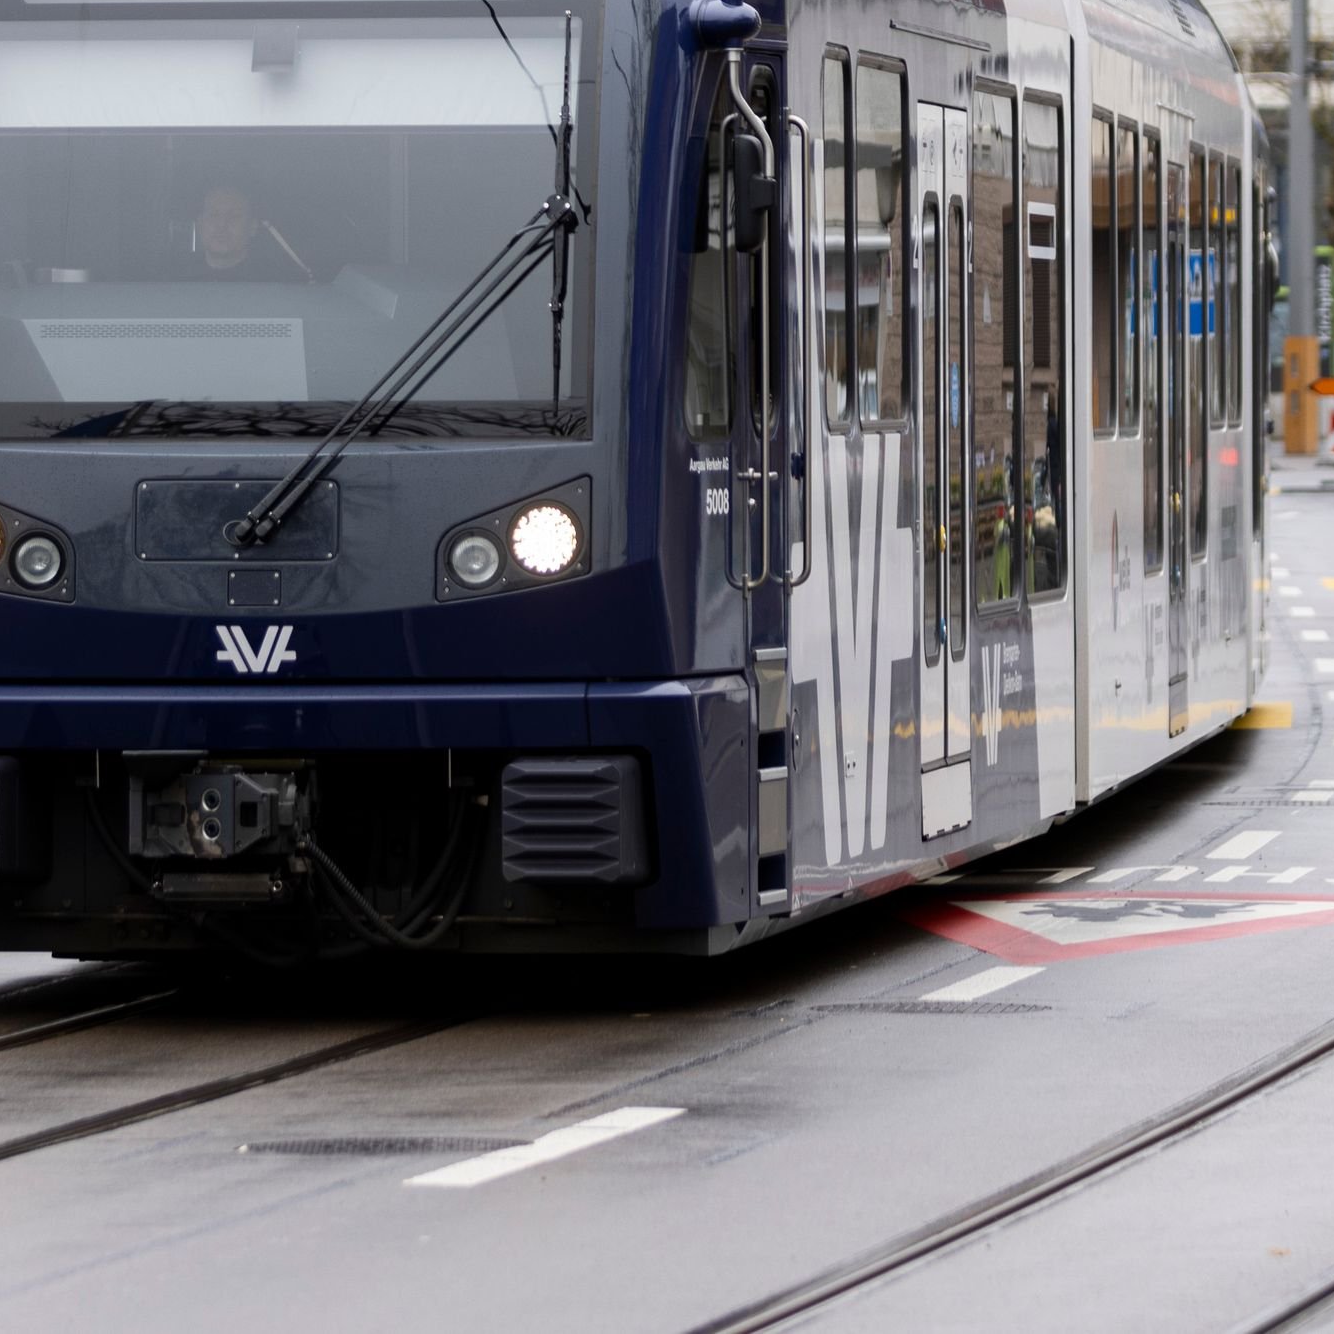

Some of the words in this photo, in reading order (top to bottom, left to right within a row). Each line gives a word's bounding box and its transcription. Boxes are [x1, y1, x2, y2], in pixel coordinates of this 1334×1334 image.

[689, 457, 706, 474] Aargau
[705, 456, 722, 471] Verkehr
[722, 456, 730, 471] AG
[706, 488, 730, 515] 5008
